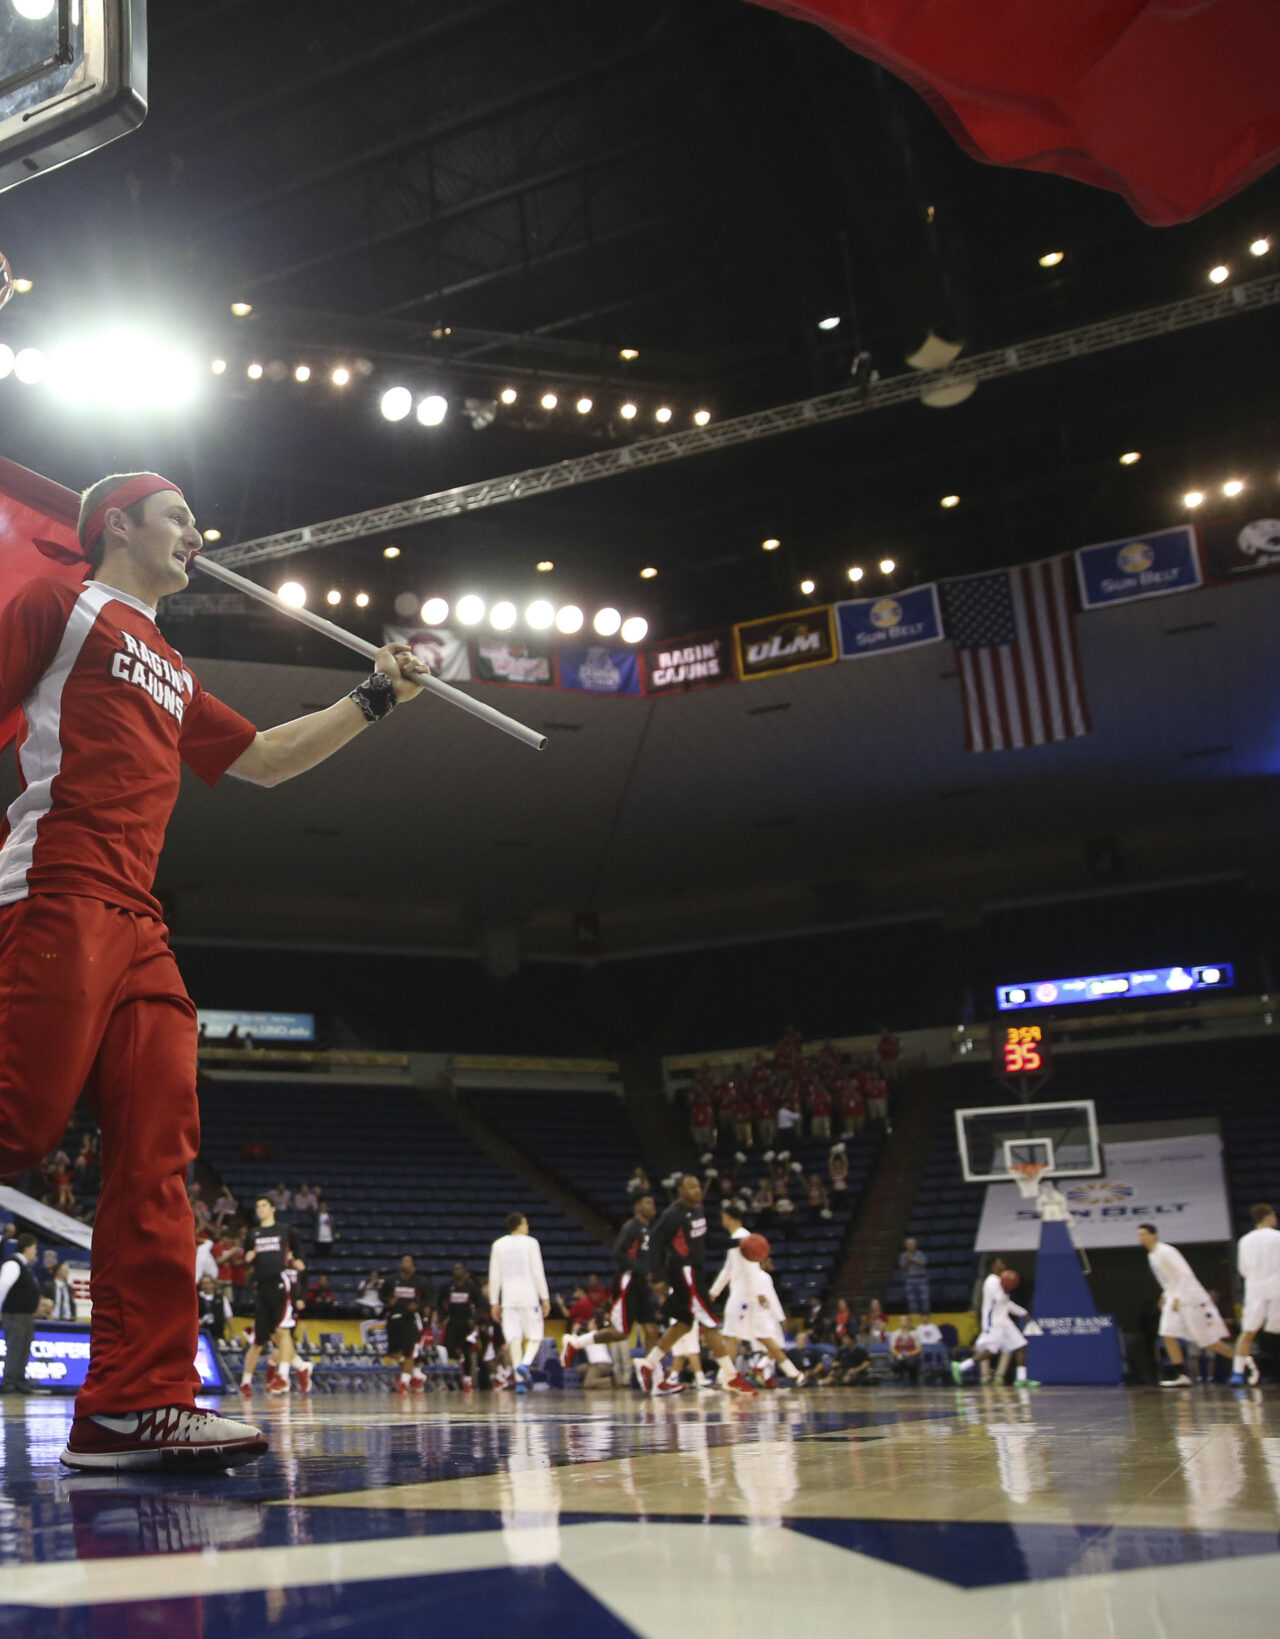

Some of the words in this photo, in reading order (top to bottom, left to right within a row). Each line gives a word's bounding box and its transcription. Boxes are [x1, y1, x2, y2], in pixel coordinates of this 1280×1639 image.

[746, 631, 820, 664] ULM
[652, 658, 720, 686] CAJUNS
[111, 651, 185, 727] CAJUNS
[1004, 1042, 1042, 1072] 35
[1102, 1202, 1190, 1218] BELT
